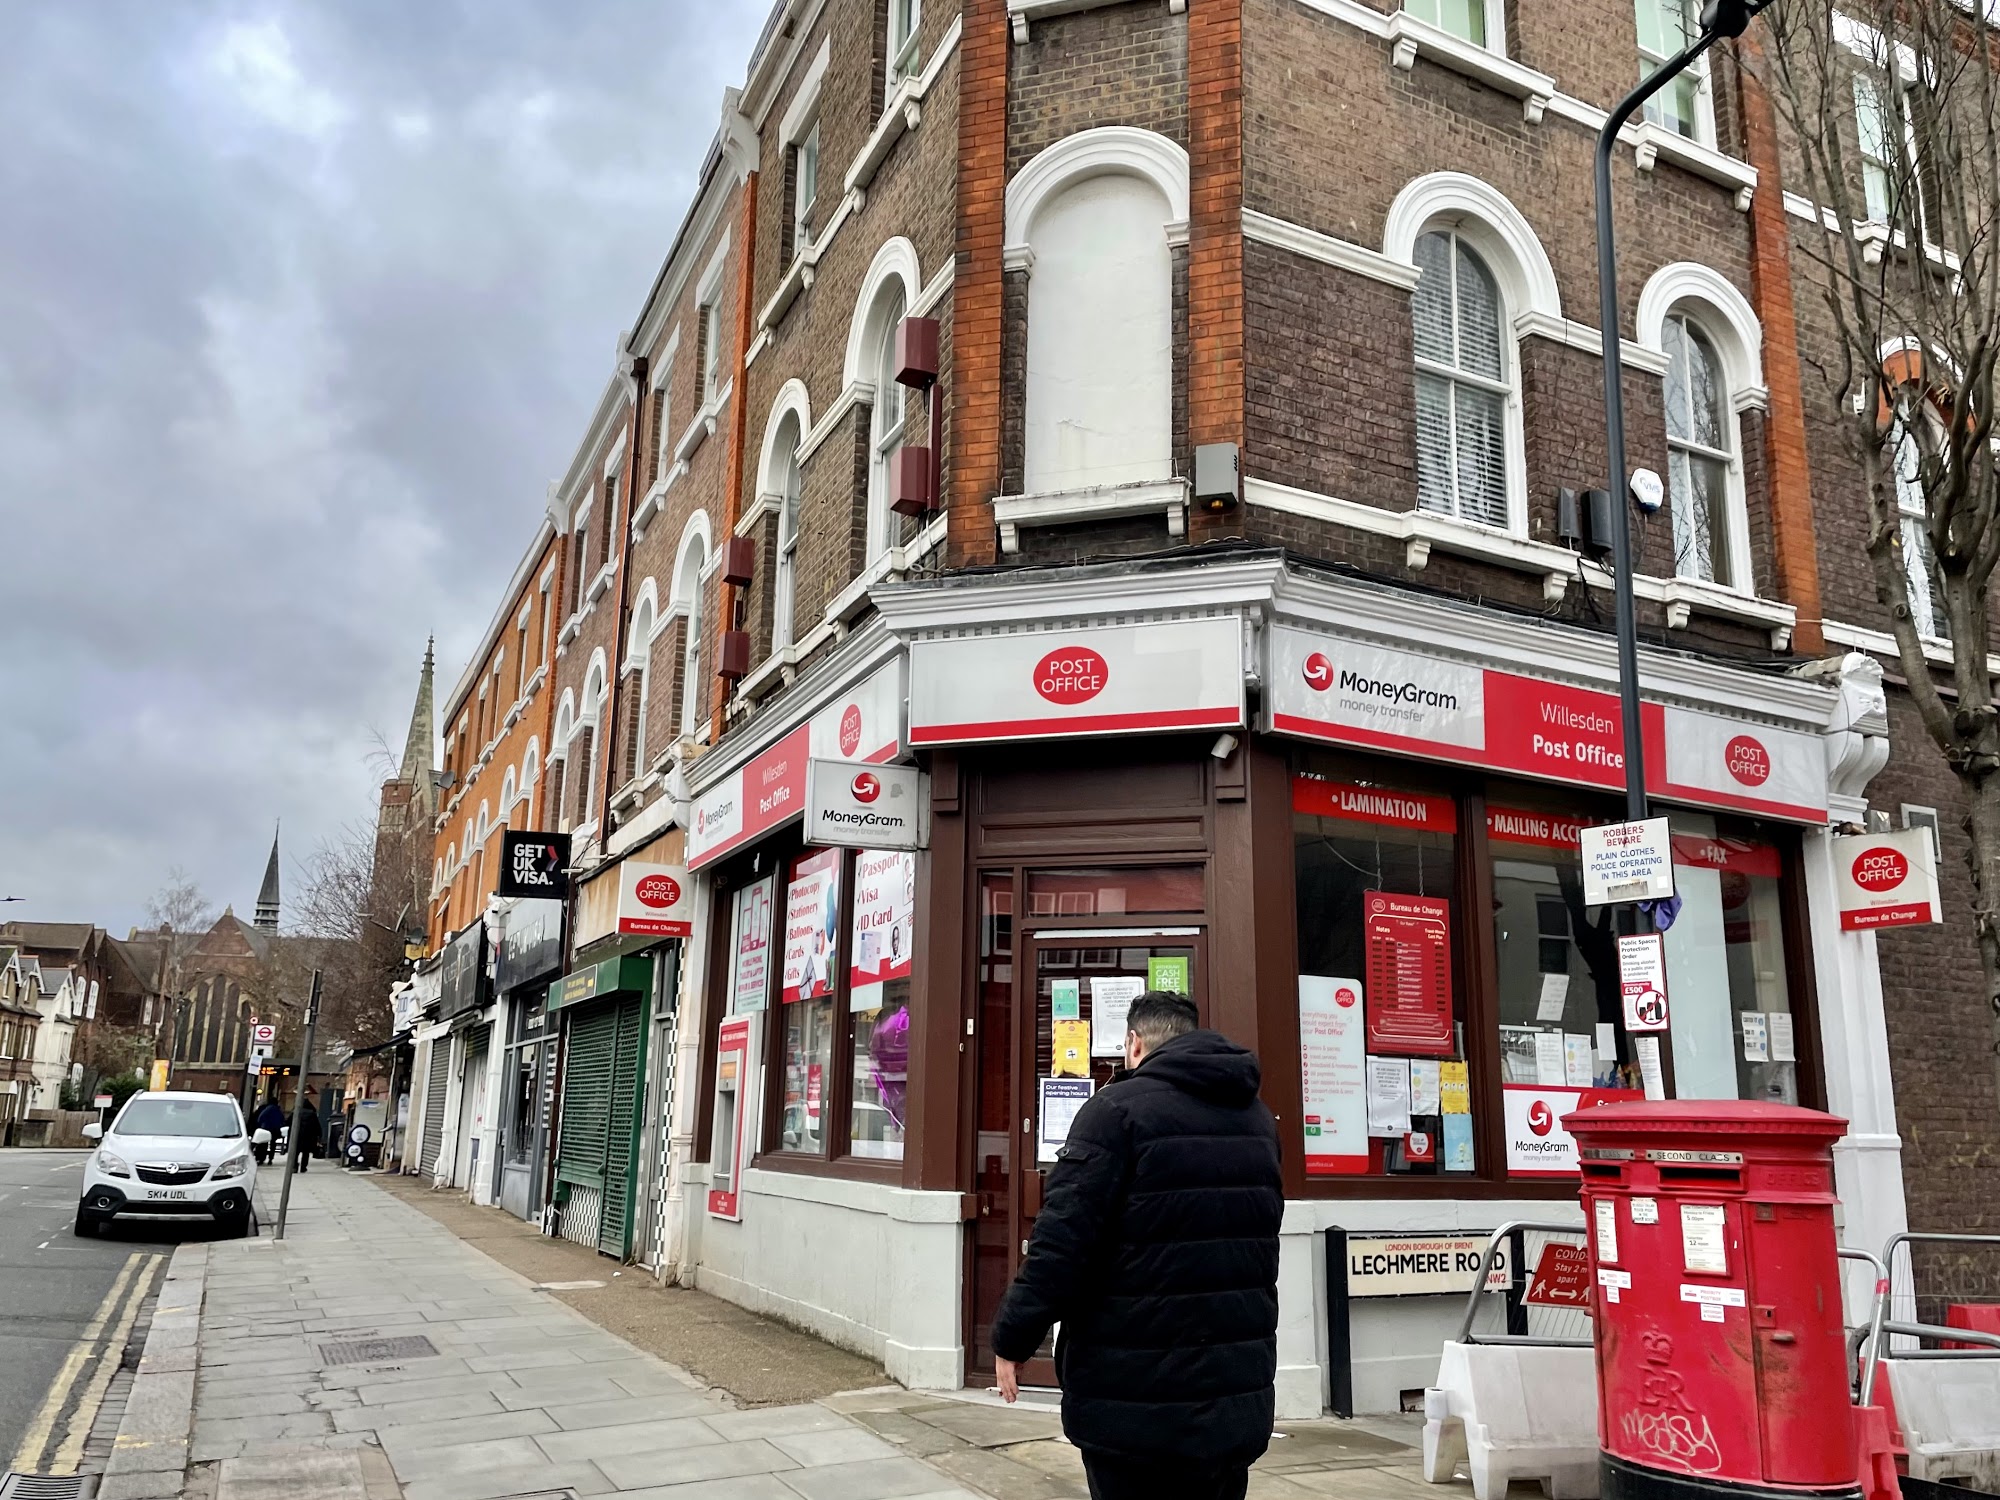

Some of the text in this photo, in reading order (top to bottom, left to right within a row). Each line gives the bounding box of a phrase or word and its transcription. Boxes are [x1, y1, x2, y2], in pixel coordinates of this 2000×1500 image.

[1050, 658, 1095, 676] POST
[1041, 675, 1100, 693] OFFICE
[1340, 670, 1457, 710] MoneyGram
[1340, 698, 1425, 722] money transfer
[843, 712, 858, 731] POST
[1540, 701, 1614, 735] Willesden
[841, 727, 860, 749] OFFICE
[1533, 734, 1624, 769] Post Office
[1733, 745, 1762, 763] POST
[762, 759, 788, 786] Willesden
[1730, 760, 1767, 778] OFFICE
[760, 786, 790, 814] Post Office
[1340, 791, 1427, 822] LAMINATION
[705, 799, 733, 828] MoneyGram
[823, 809, 904, 827] MoneyGram
[833, 826, 891, 837] money transfer
[1494, 814, 1549, 839] MAILING
[1603, 825, 1645, 838] ROBBERS
[1606, 835, 1642, 847] BEWARE
[513, 843, 546, 858] GET
[1596, 847, 1655, 861] PLAIN CLOTHES
[1707, 848, 1728, 864] FAX
[513, 856, 537, 870] UK
[862, 852, 901, 878] Passport
[1590, 857, 1663, 871] POLICE OPERATING
[1863, 855, 1896, 870] POST
[512, 870, 554, 885] VISA.
[1612, 871, 1629, 879] THIS
[1631, 868, 1652, 877] AREA
[1857, 867, 1902, 883] OFFICE
[646, 881, 673, 891] POST
[791, 881, 821, 900] Photocopy
[639, 889, 676, 901] OFFICE
[861, 887, 879, 905] Visa
[790, 901, 819, 921] Stationery
[1390, 902, 1412, 913] Bureau
[1413, 905, 1420, 913] de
[1422, 906, 1443, 916] Change
[1854, 910, 1918, 923] Bureau de Change
[860, 906, 893, 931] ID Card
[630, 922, 650, 930] Bureau
[660, 924, 681, 932] Change
[789, 924, 814, 941] Balloons
[1621, 945, 1649, 953] Protection
[1638, 938, 1657, 946] Spaces
[788, 946, 805, 960] Cards
[787, 968, 800, 980] Gifts
[1156, 978, 1180, 988] FREE
[1624, 986, 1643, 994] £500
[1328, 1028, 1343, 1036] Office
[1515, 1140, 1569, 1154] MoneyGram
[1656, 1152, 1692, 1160] SECOND
[147, 1190, 188, 1199] SK14 UDL
[1385, 1241, 1473, 1251] LONDON BOROUGH OF BRENT
[1555, 1249, 1588, 1260] COVID-
[1351, 1253, 1450, 1276] LECHMERE
[1554, 1263, 1572, 1275] Stay
[1573, 1265, 1580, 1273] 2
[1486, 1273, 1507, 1285] NW2
[1556, 1275, 1578, 1285] apart
